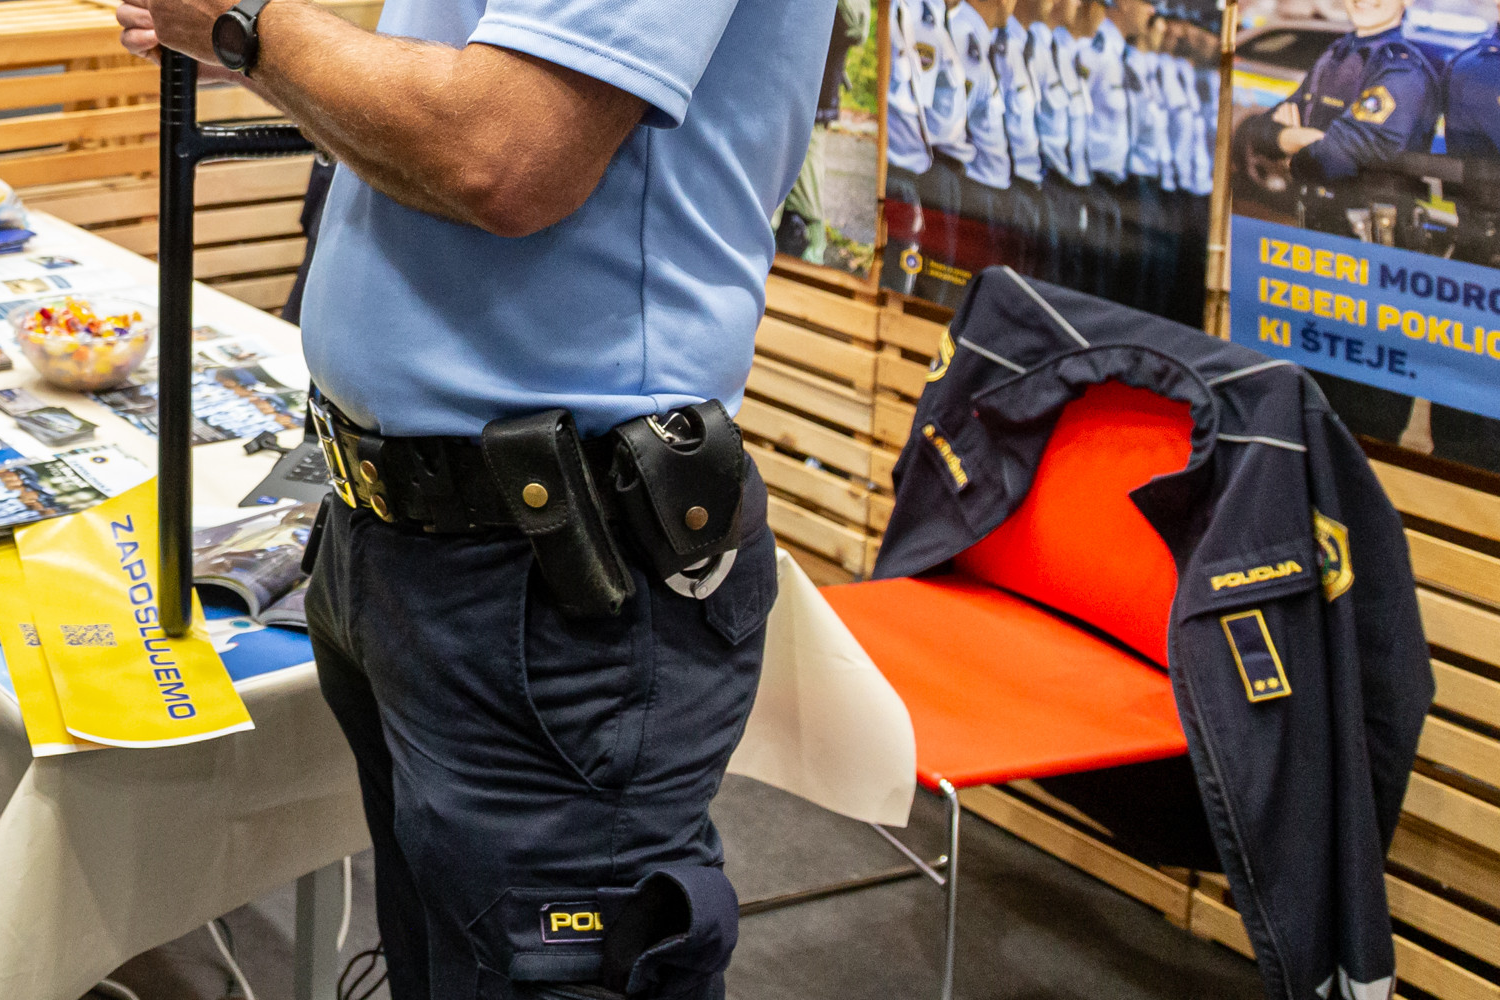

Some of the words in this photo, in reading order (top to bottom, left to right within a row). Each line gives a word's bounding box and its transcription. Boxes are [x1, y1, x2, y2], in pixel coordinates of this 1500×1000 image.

[1259, 237, 1369, 286] IZBERI
[1258, 277, 1368, 327] IZBERI
[1258, 316, 1292, 347] KI
[1300, 318, 1417, 379] ŠTEJE.
[1210, 560, 1303, 591] POLICIJA
[110, 514, 197, 720] ZAPOSLUJEMO
